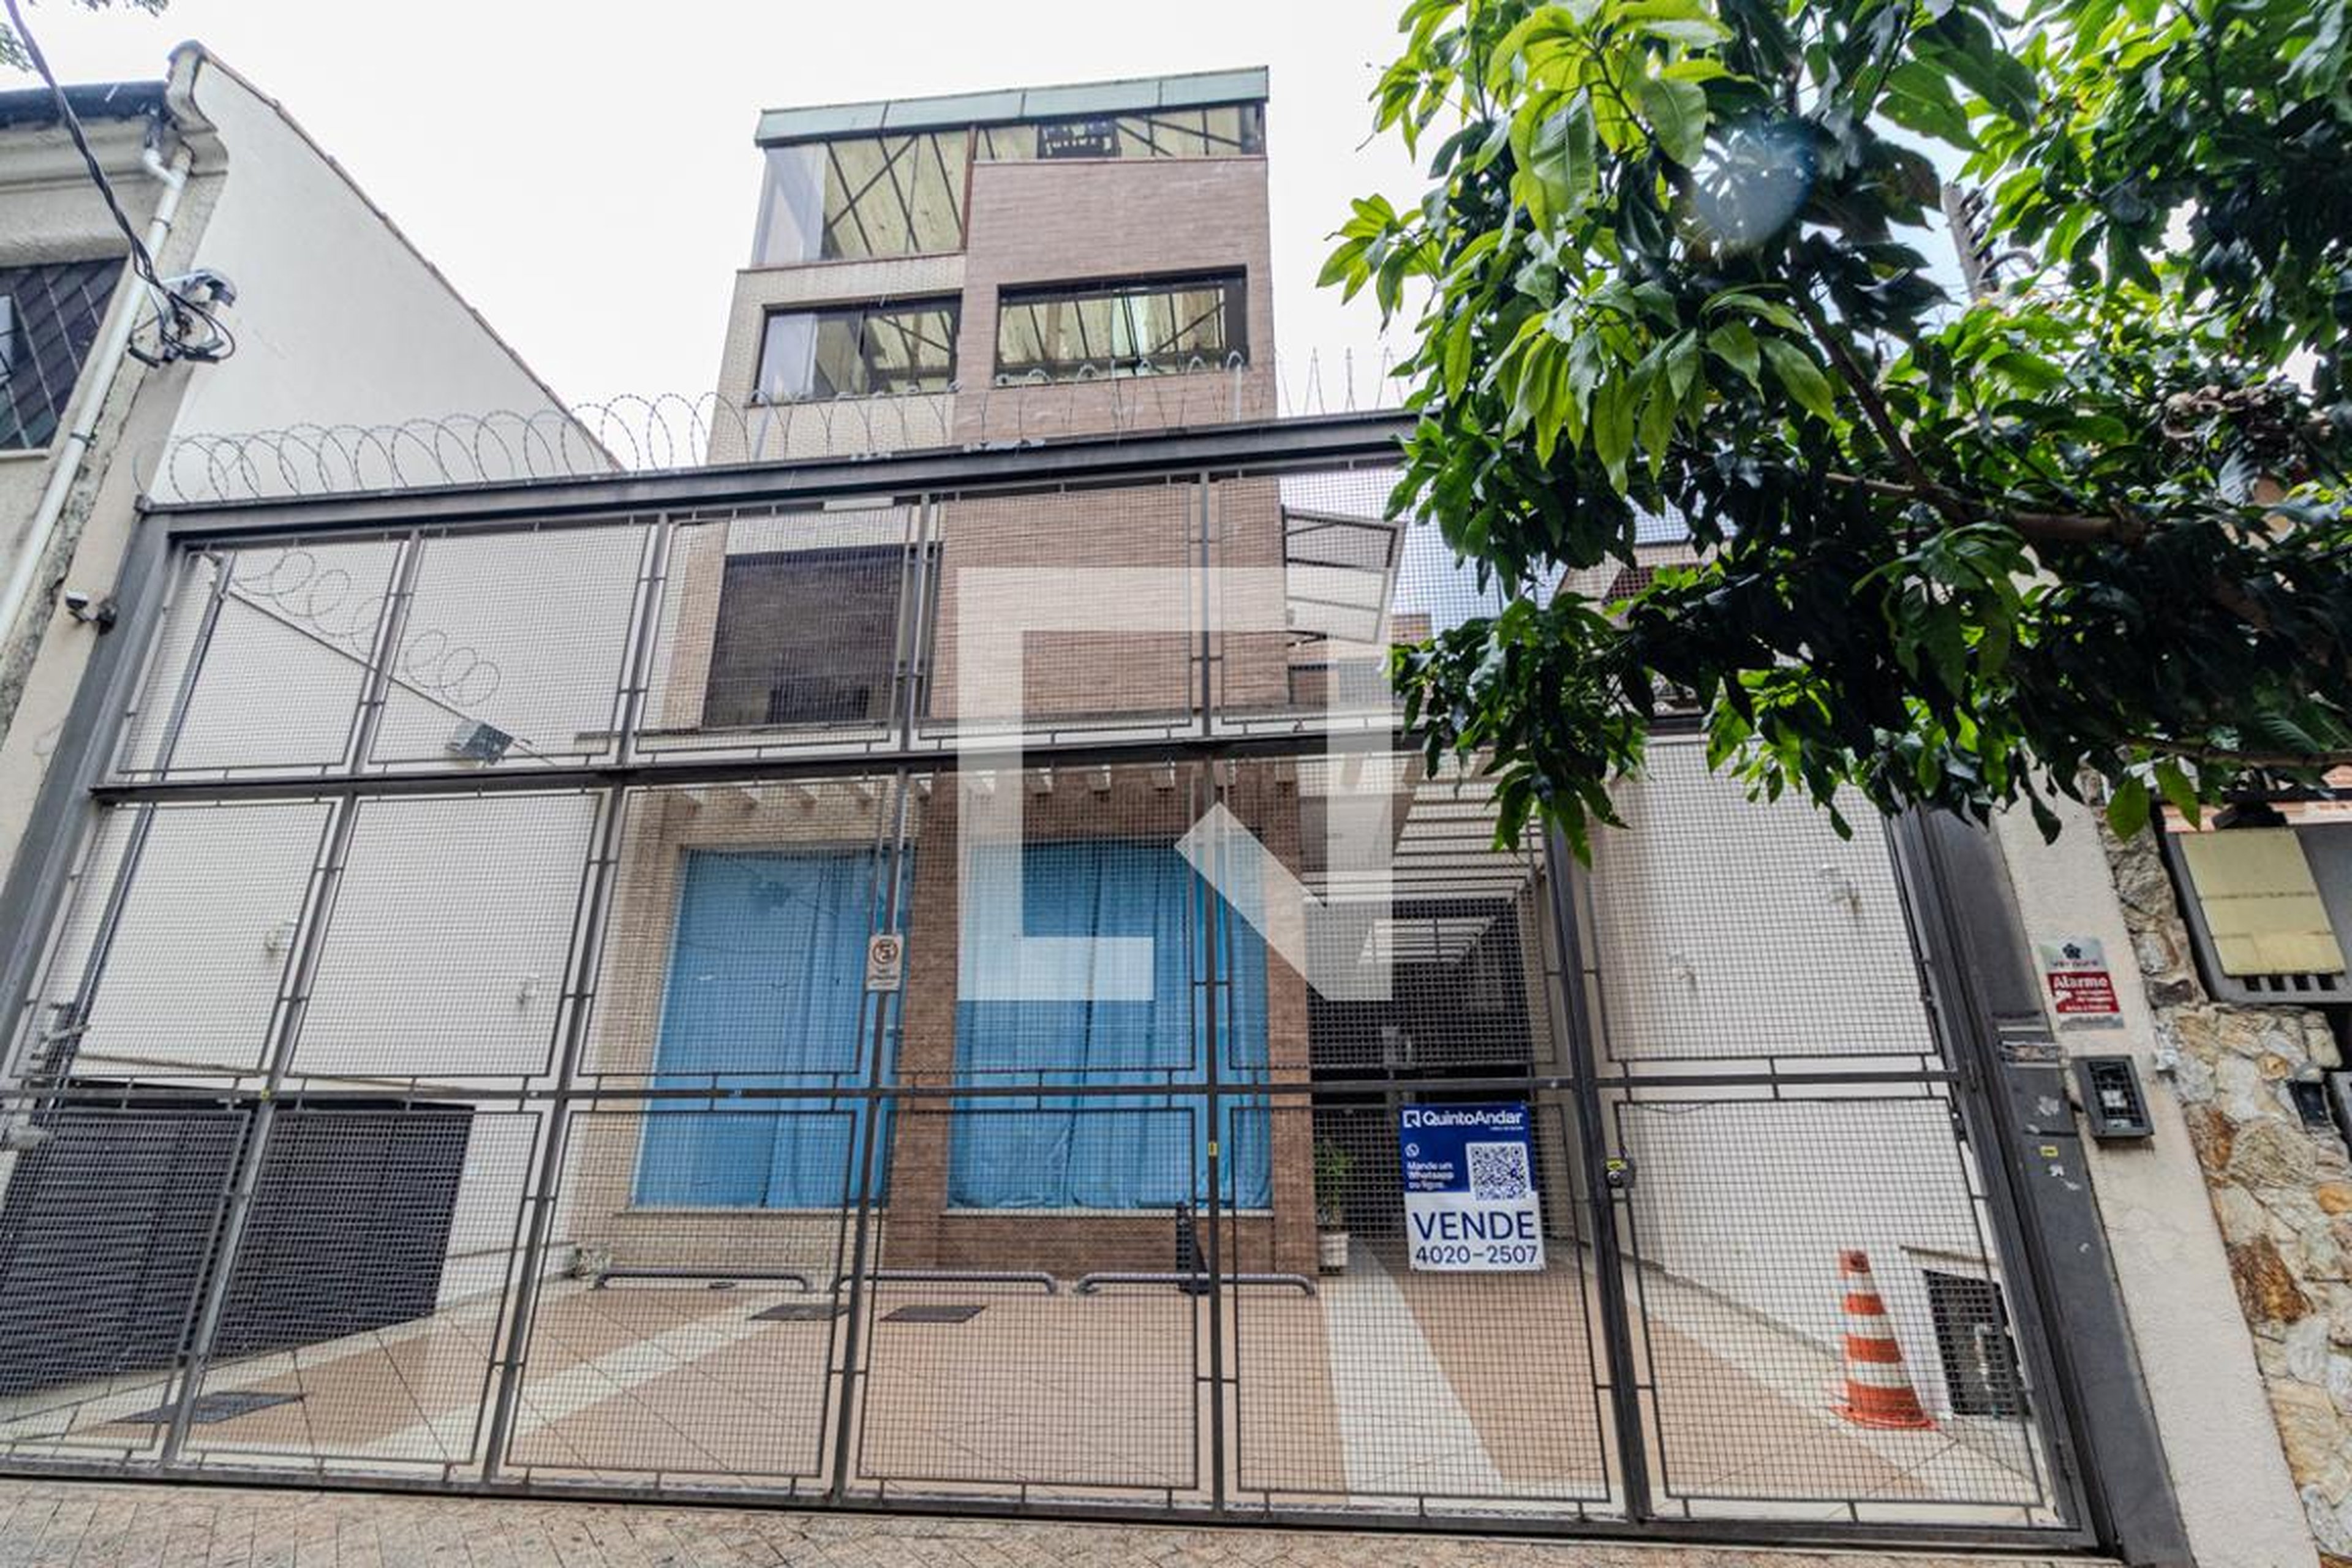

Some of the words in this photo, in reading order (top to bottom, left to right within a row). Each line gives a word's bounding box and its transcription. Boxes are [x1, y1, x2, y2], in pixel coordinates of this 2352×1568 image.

[2054, 976, 2108, 989] Alarme
[1423, 1110, 1523, 1126] QuintoAndar
[1413, 1212, 1536, 1240] VENDE
[1416, 1246, 1537, 1264] 4020-2507
